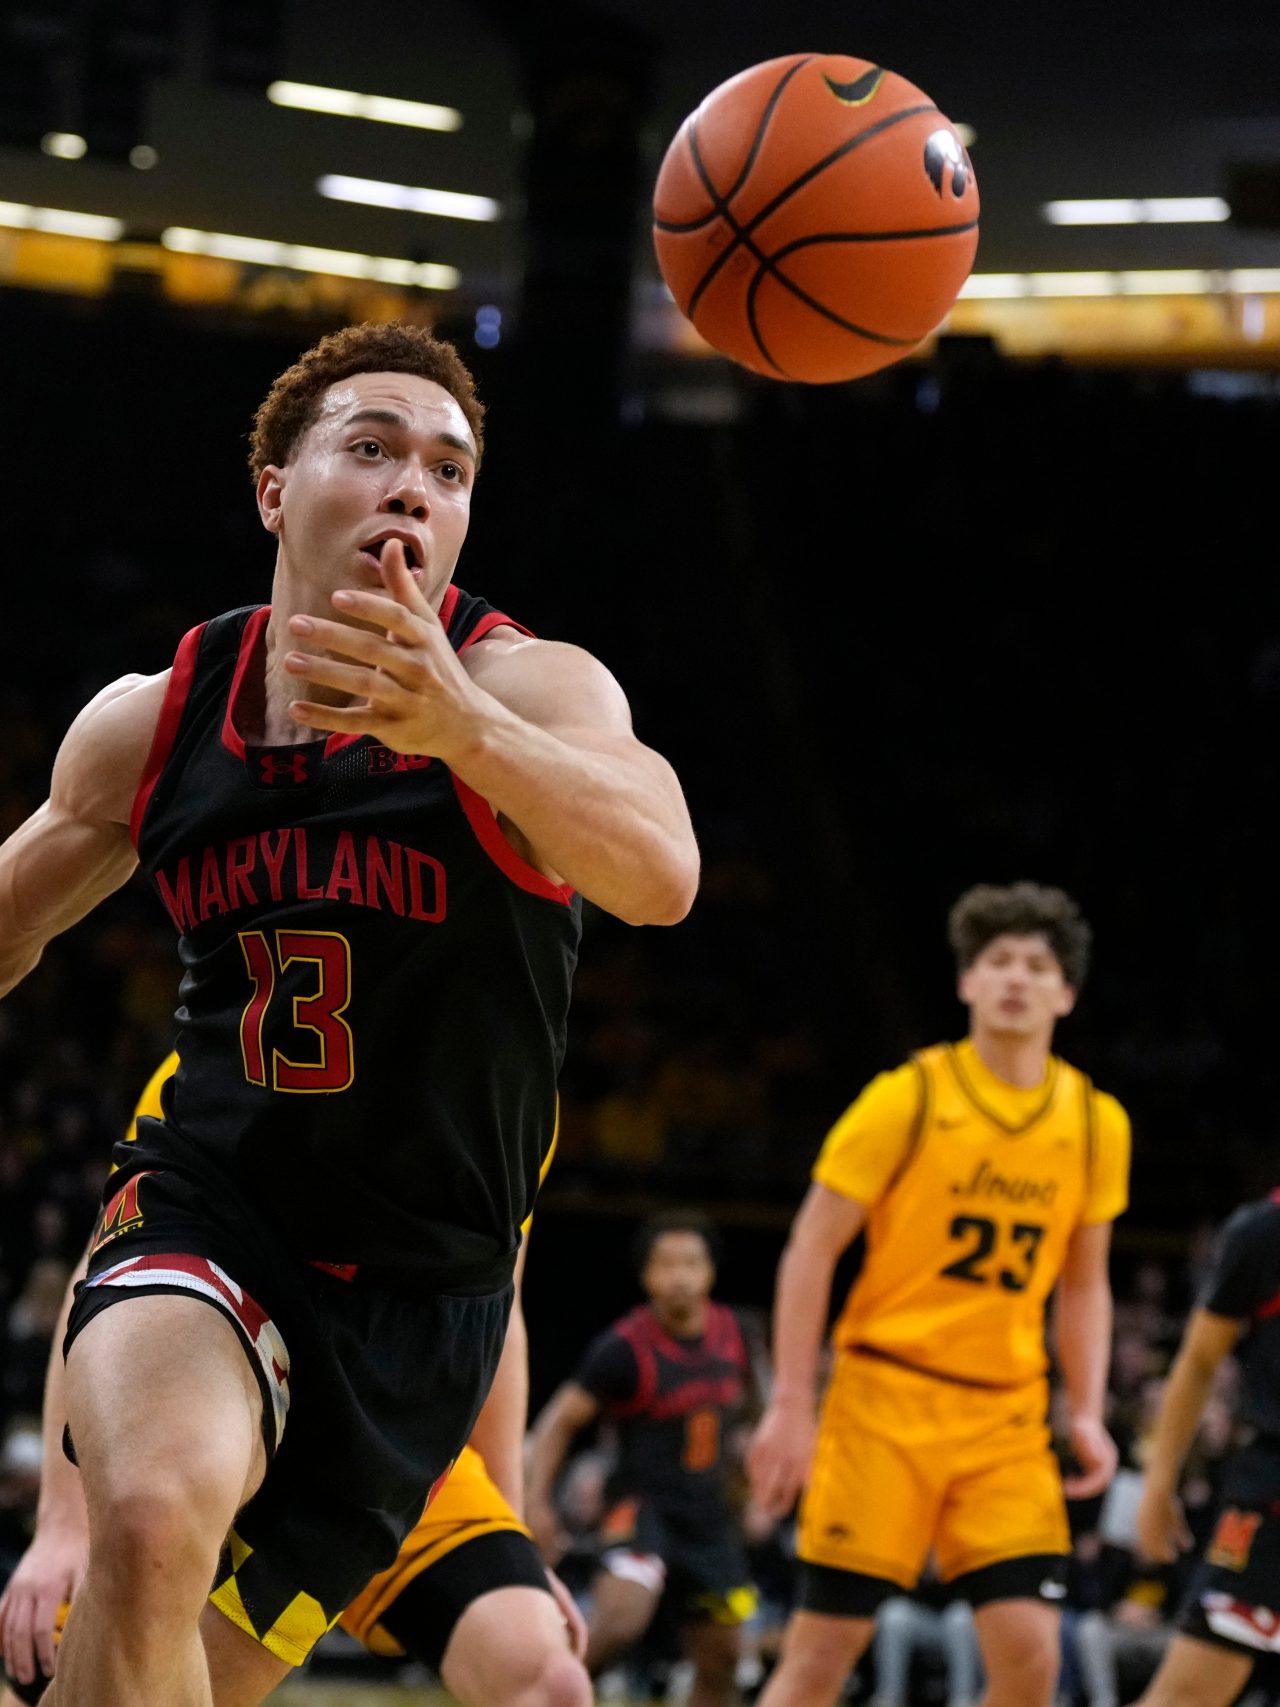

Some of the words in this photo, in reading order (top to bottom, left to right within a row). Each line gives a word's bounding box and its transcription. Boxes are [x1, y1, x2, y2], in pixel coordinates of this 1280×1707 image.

[155, 827, 447, 934] MARYLAND
[237, 928, 355, 1094] 13
[940, 1214, 1045, 1292] 23
